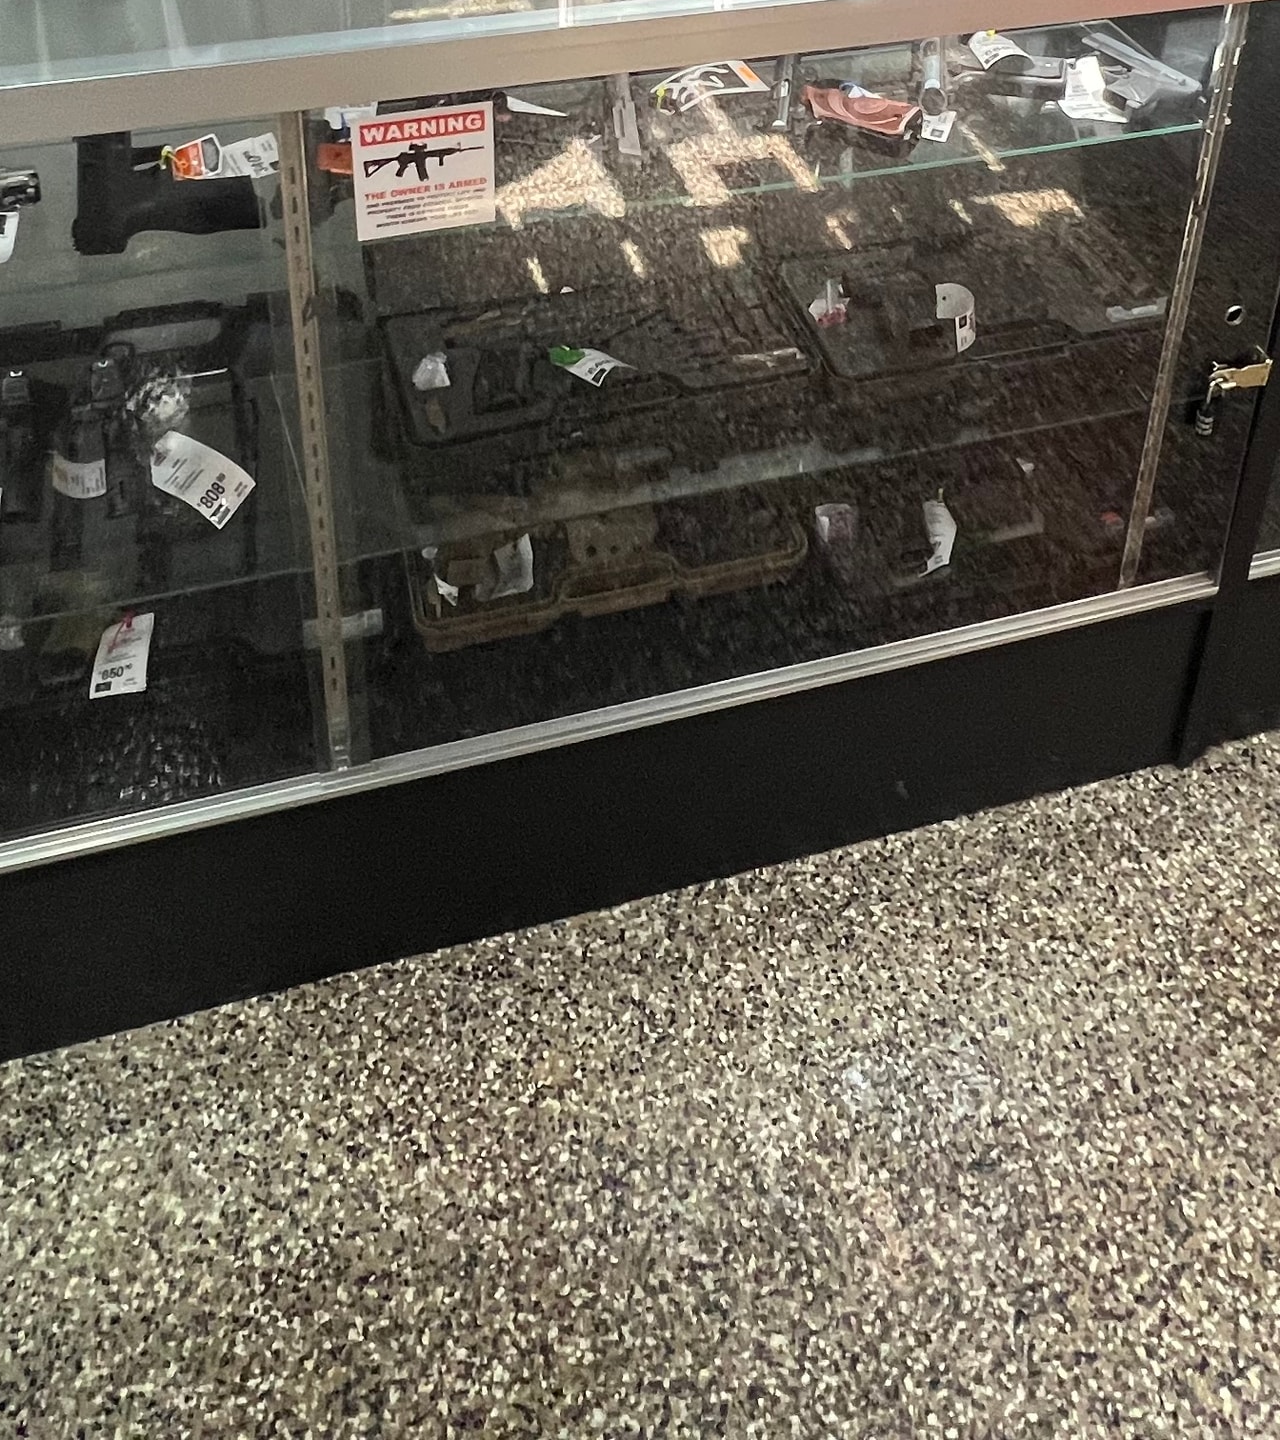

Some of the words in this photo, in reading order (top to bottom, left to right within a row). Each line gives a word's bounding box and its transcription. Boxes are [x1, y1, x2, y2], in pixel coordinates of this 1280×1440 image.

[361, 114, 482, 144] WARNING
[365, 192, 387, 201] THE
[390, 186, 431, 198] OWNER
[448, 178, 488, 190] ARMED
